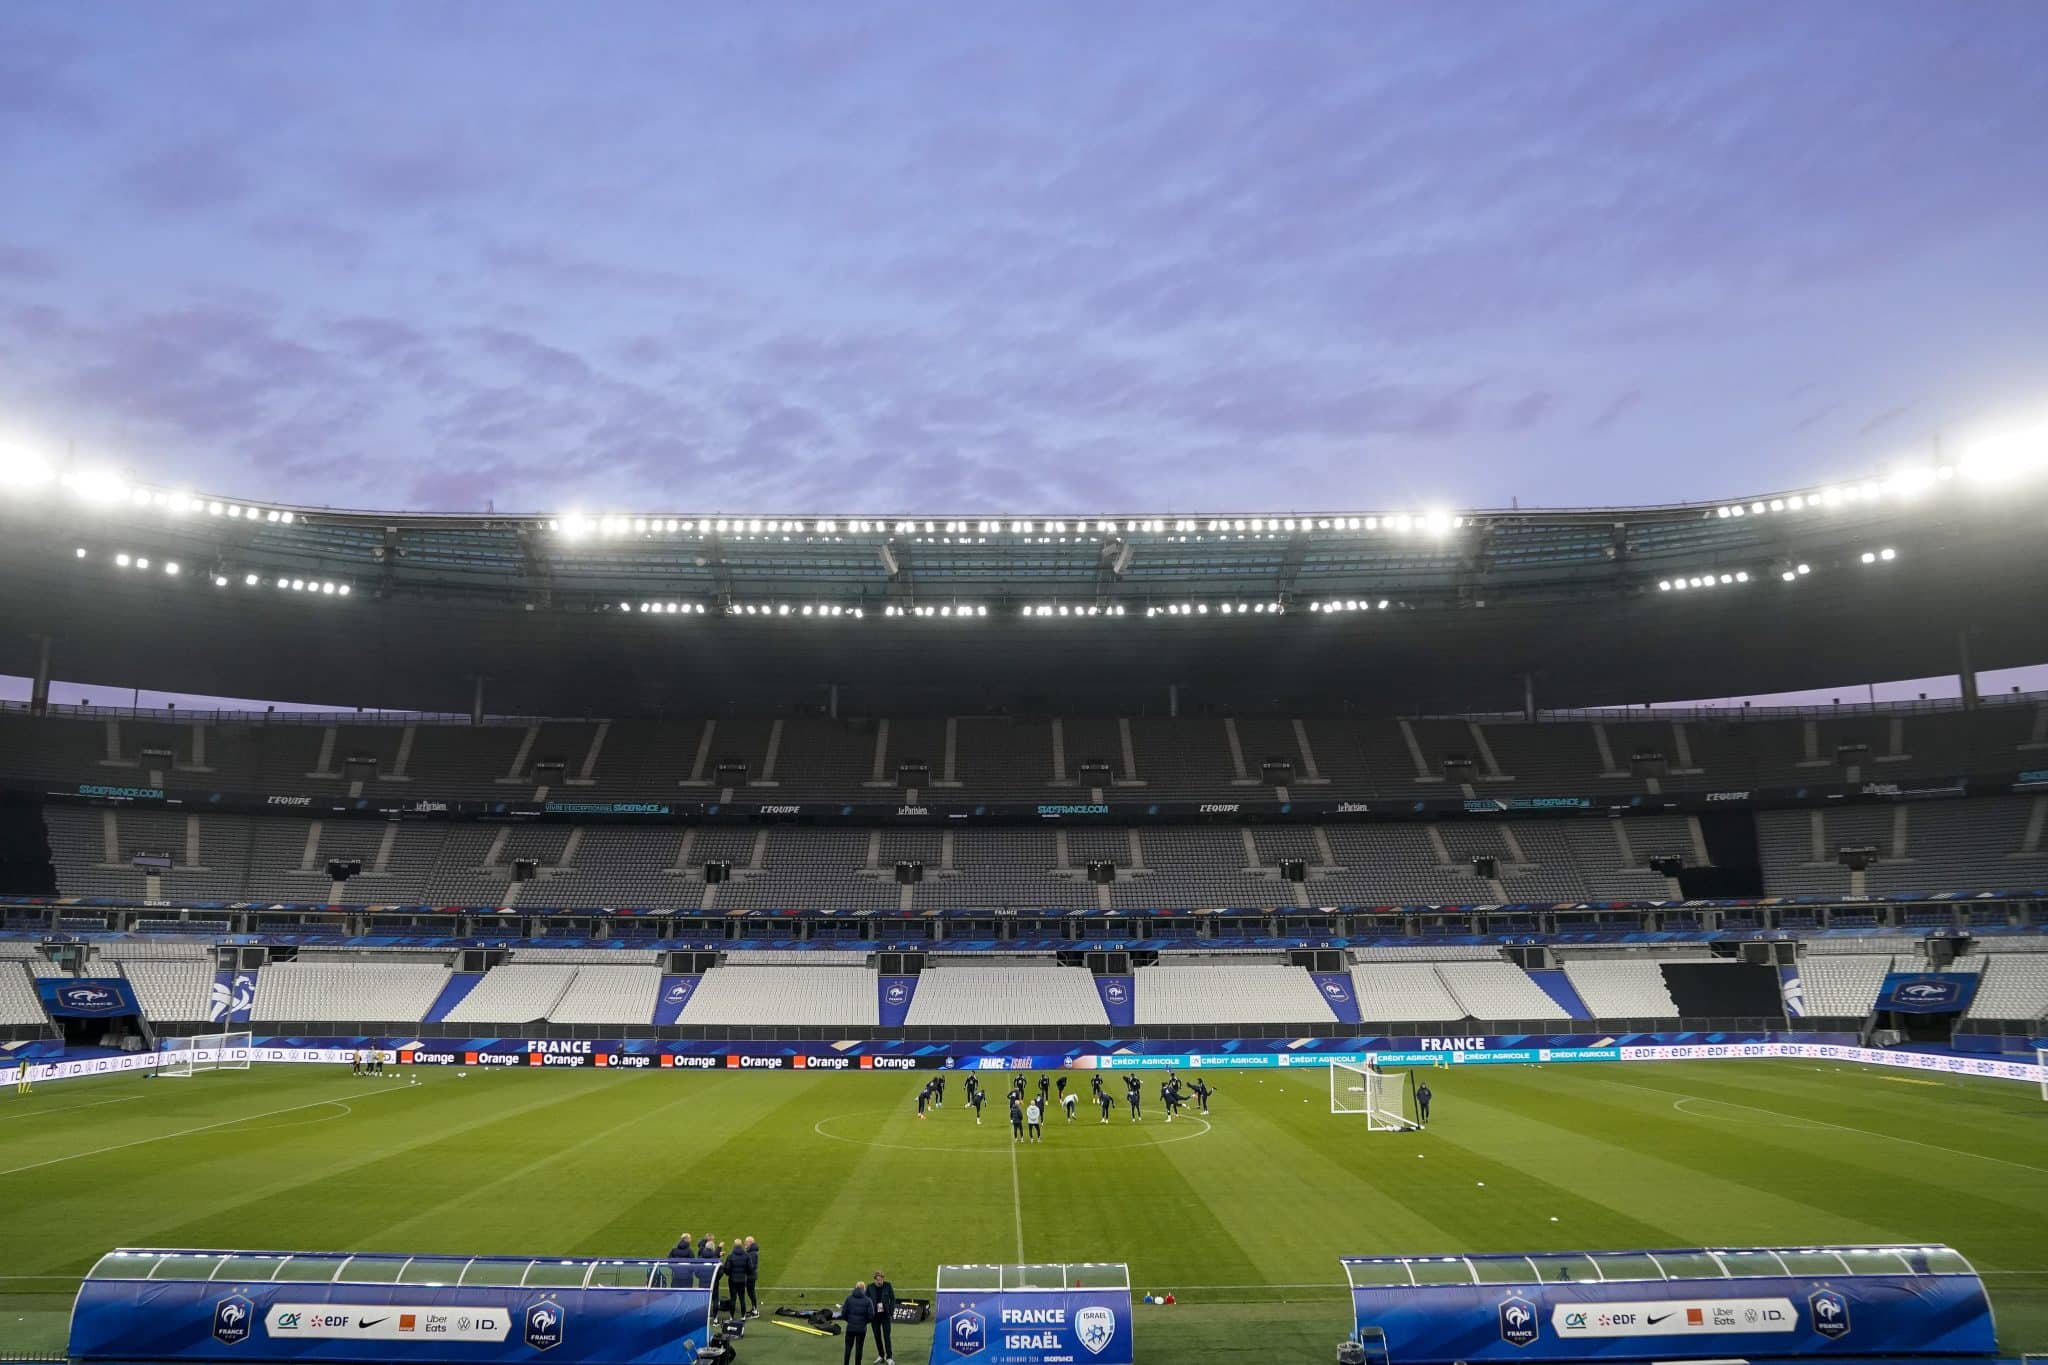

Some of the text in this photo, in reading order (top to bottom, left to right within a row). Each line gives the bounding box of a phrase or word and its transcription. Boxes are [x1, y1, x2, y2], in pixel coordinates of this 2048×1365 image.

[527, 1041, 592, 1053] FRANCE
[1421, 1037, 1486, 1051] FRANCE
[414, 1052, 455, 1065] Orange
[479, 1053, 520, 1065] Orange
[543, 1053, 585, 1066] Orange
[675, 1055, 716, 1067] Orange
[741, 1055, 782, 1068] Orange
[807, 1056, 849, 1069] Orange
[874, 1056, 916, 1069] Orange
[1002, 1309, 1065, 1323] FRANCE
[1083, 1312, 1106, 1320] ISRAEL
[1712, 1307, 1733, 1316] Uber
[1762, 1310, 1785, 1321] ID.
[426, 1314, 447, 1323] Uber
[475, 1319, 498, 1330] ID.
[1714, 1317, 1736, 1326] Eats
[425, 1324, 447, 1332] Eats
[1006, 1332, 1062, 1350] ISRAËL
